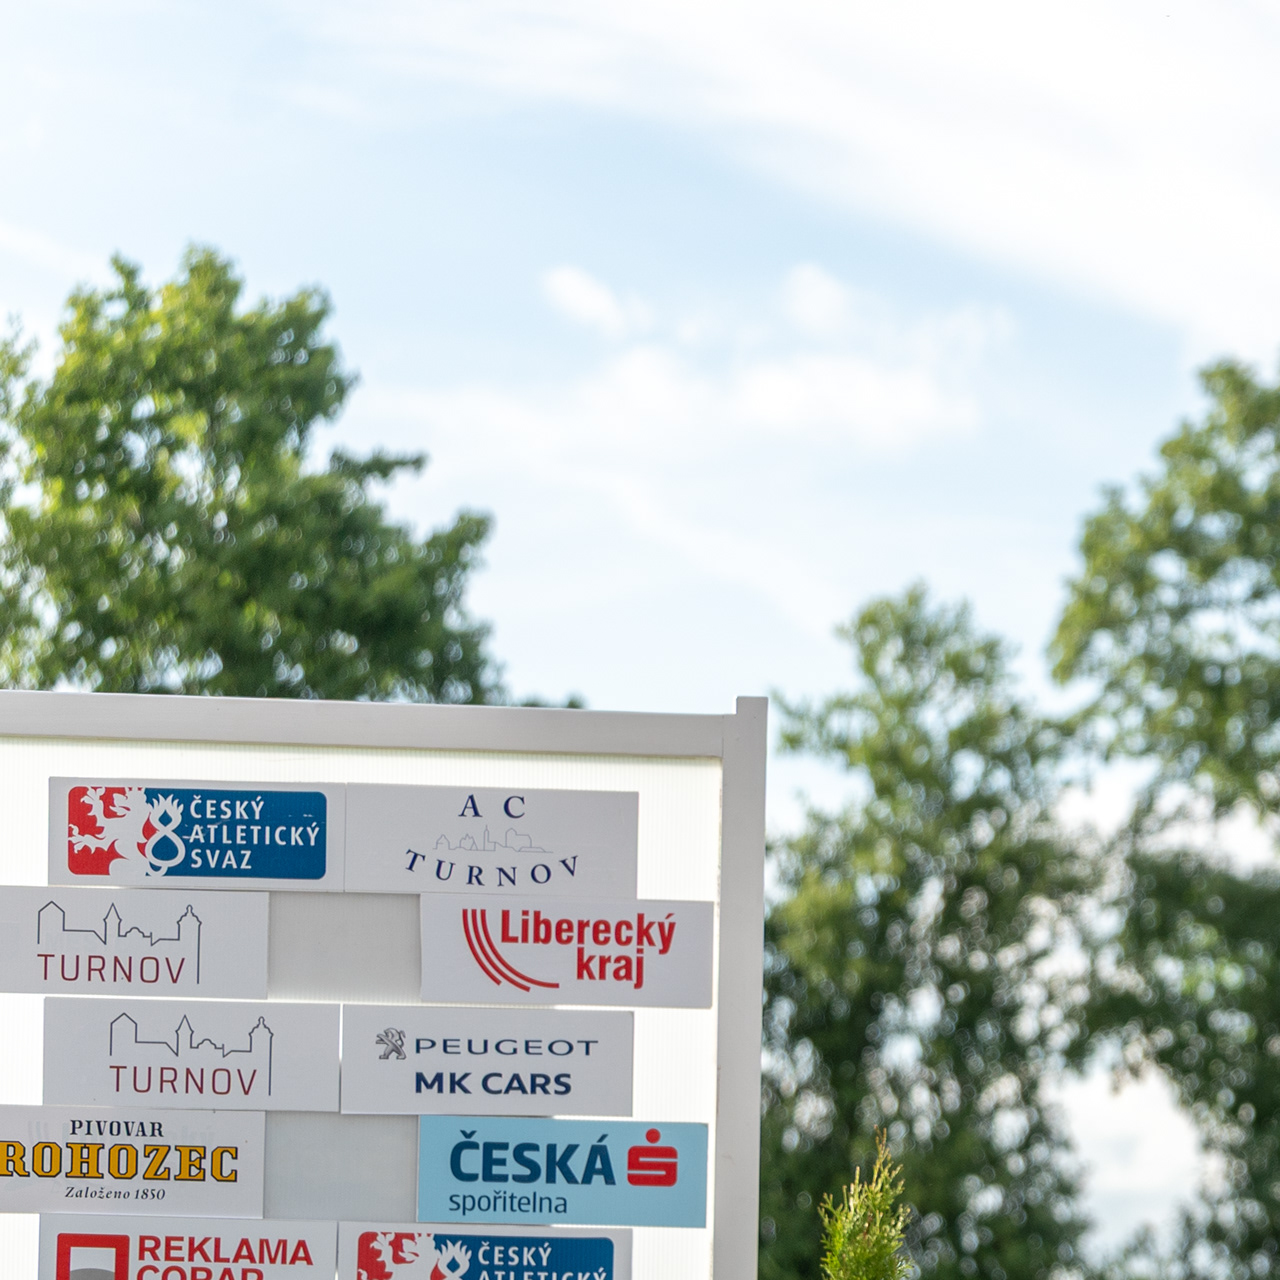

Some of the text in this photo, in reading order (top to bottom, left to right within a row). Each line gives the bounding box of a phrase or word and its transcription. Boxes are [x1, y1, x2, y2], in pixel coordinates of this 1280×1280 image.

[189, 795, 264, 820] ČESKÝ
[188, 821, 321, 846] ATLETICKÝ
[190, 849, 252, 870] SVAZ
[404, 849, 579, 887] TURNOV
[500, 909, 676, 954] Liberecký
[37, 954, 186, 984] TURNOV
[576, 947, 644, 989] kraj
[415, 1038, 598, 1056] PEUGEOT
[110, 1065, 257, 1096] TURNOV
[415, 1072, 572, 1096] MK CARS
[70, 1120, 164, 1137] PIVOVAR
[0, 1141, 238, 1183] ROHOZEC
[449, 1129, 616, 1184] ČESKÁ
[65, 1186, 165, 1201] Založeno 1850
[448, 1191, 568, 1215] spořitelna
[138, 1236, 313, 1266] REKLAMA
[477, 1240, 551, 1266] ČESKÝ
